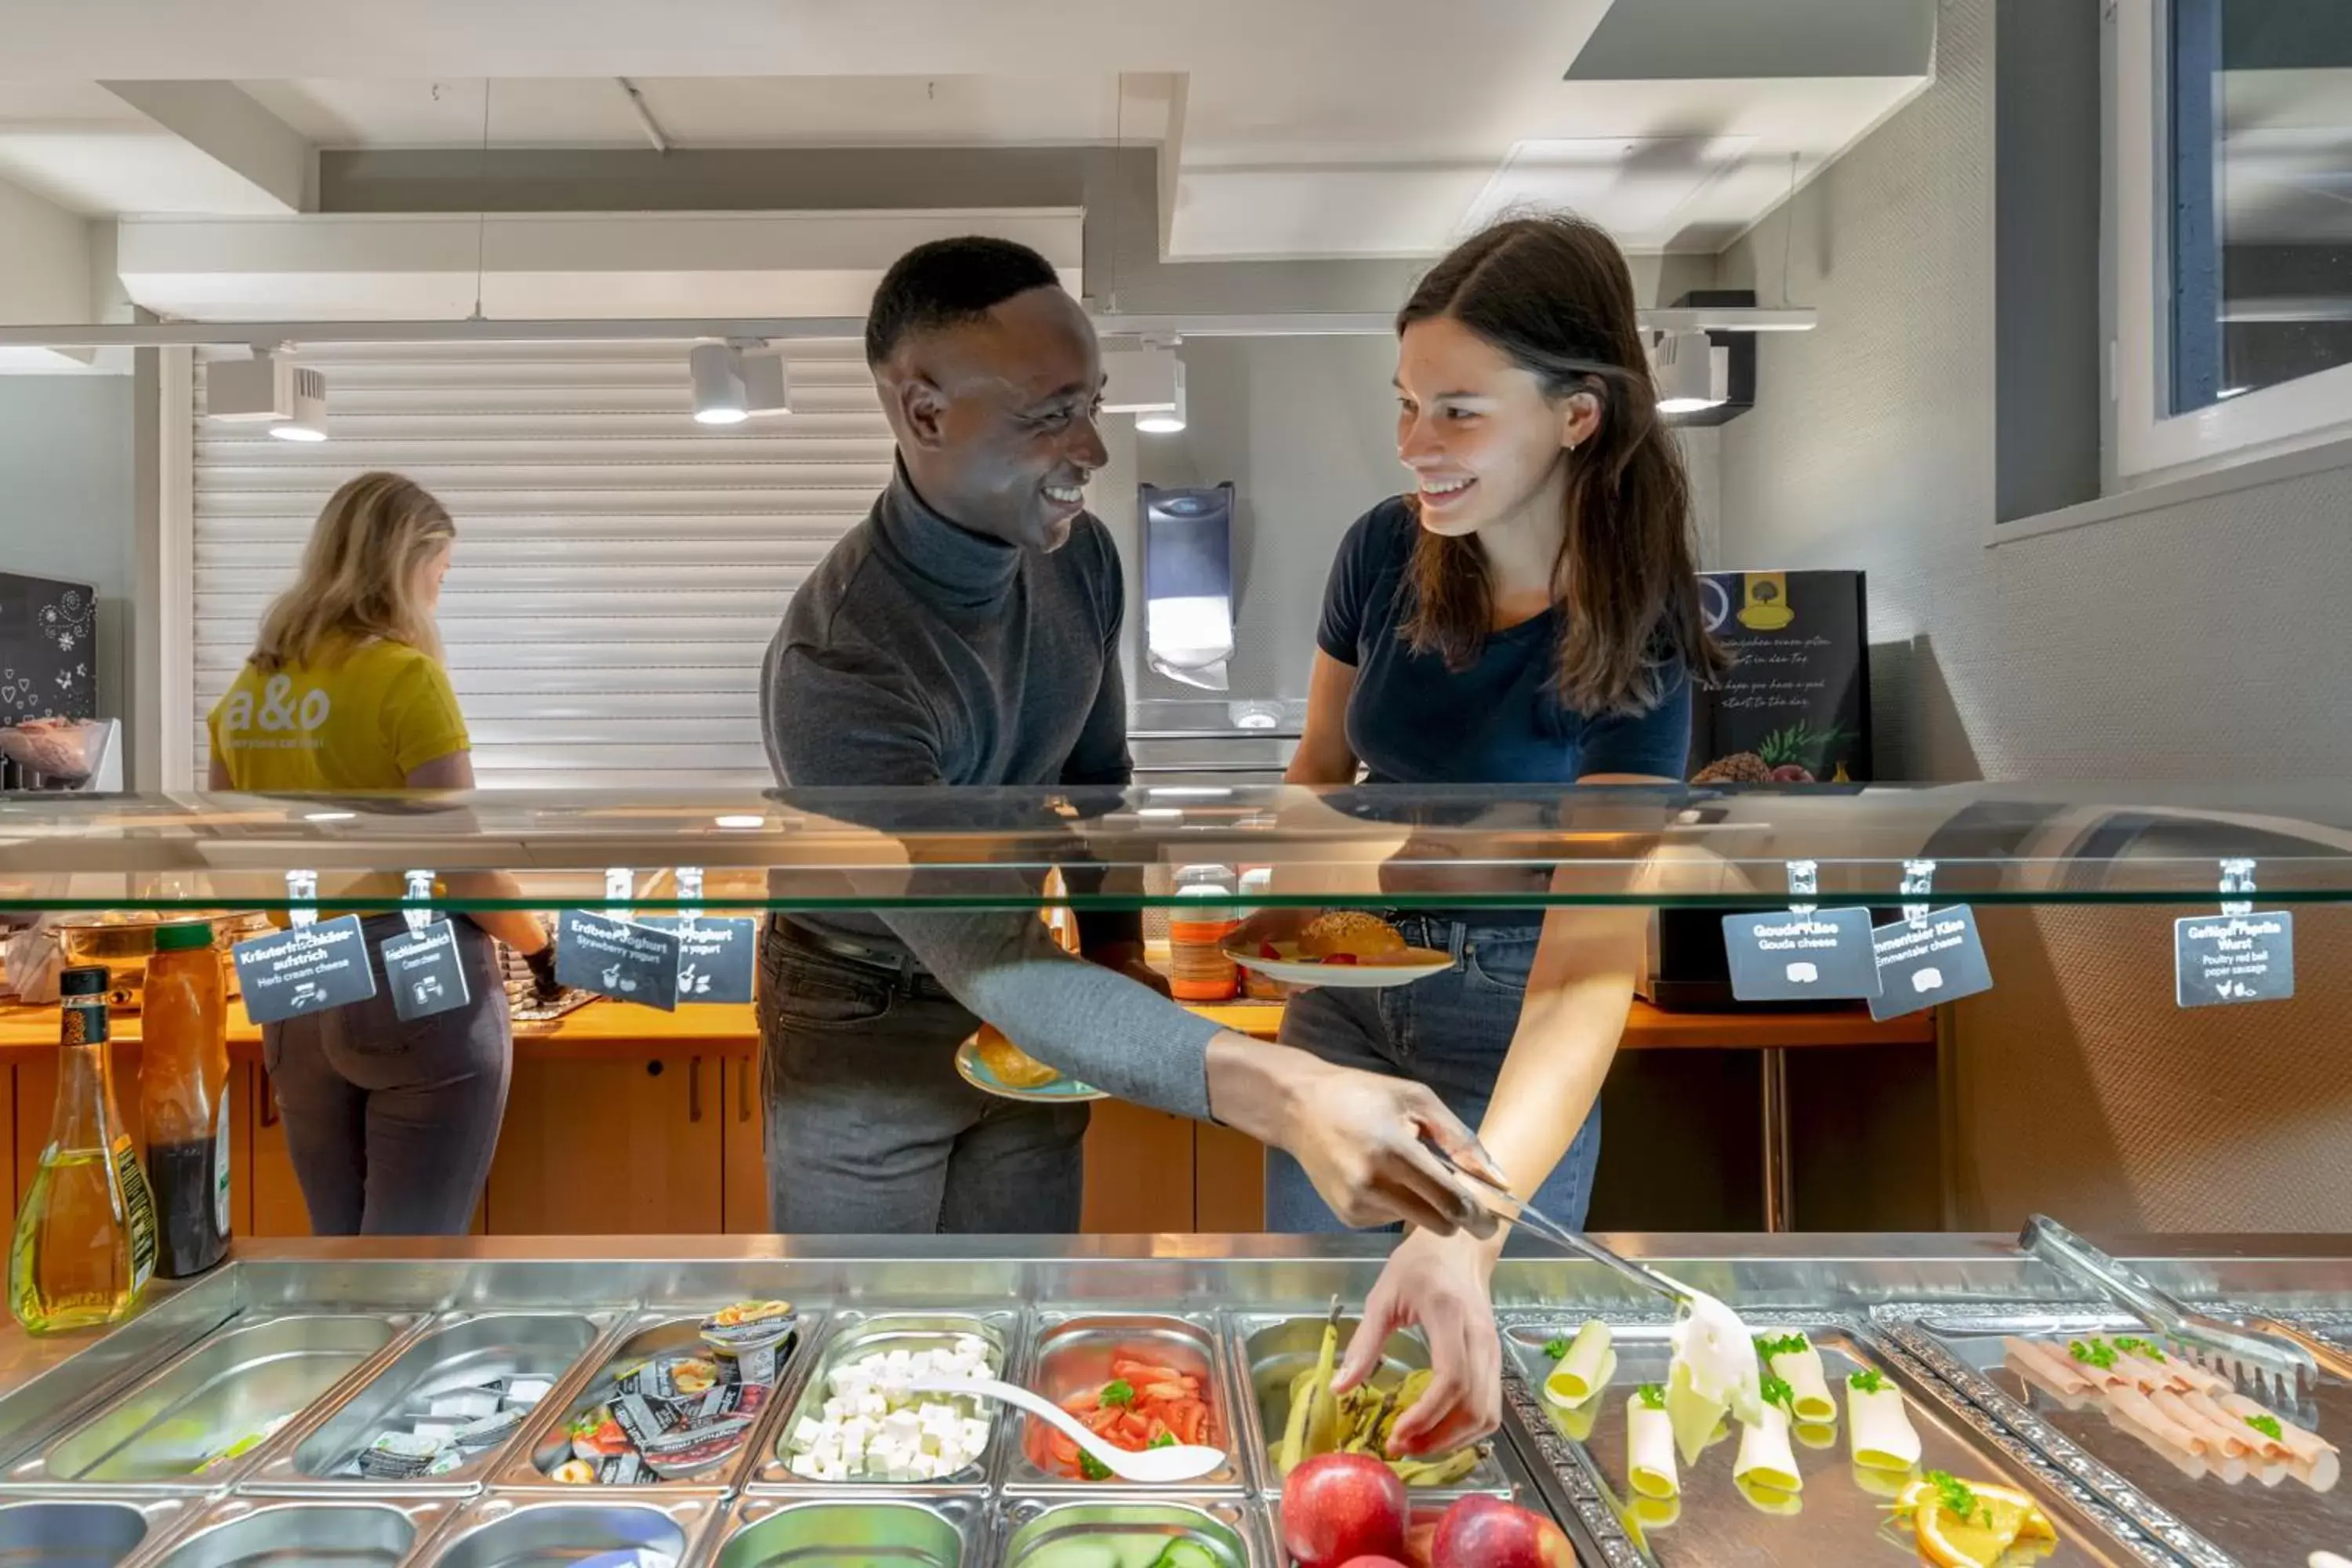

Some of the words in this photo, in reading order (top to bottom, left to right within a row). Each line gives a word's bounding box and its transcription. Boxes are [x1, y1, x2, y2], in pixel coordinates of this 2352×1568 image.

[1725, 679, 1748, 693] hope
[1751, 682, 1766, 694] you
[1769, 678, 1794, 689] have
[1802, 679, 1825, 691] good
[226, 673, 331, 731] a&o
[1721, 695, 1753, 709] start
[1754, 696, 1766, 707] to
[1767, 695, 1785, 707] the
[1753, 923, 1799, 937] Gouda
[576, 935, 627, 957] Strawberry
[1758, 938, 1795, 950] Gouda
[1797, 936, 1838, 948] cheese
[1874, 927, 1935, 953] mmentaler
[257, 973, 282, 988] Herb
[283, 967, 314, 983] cream
